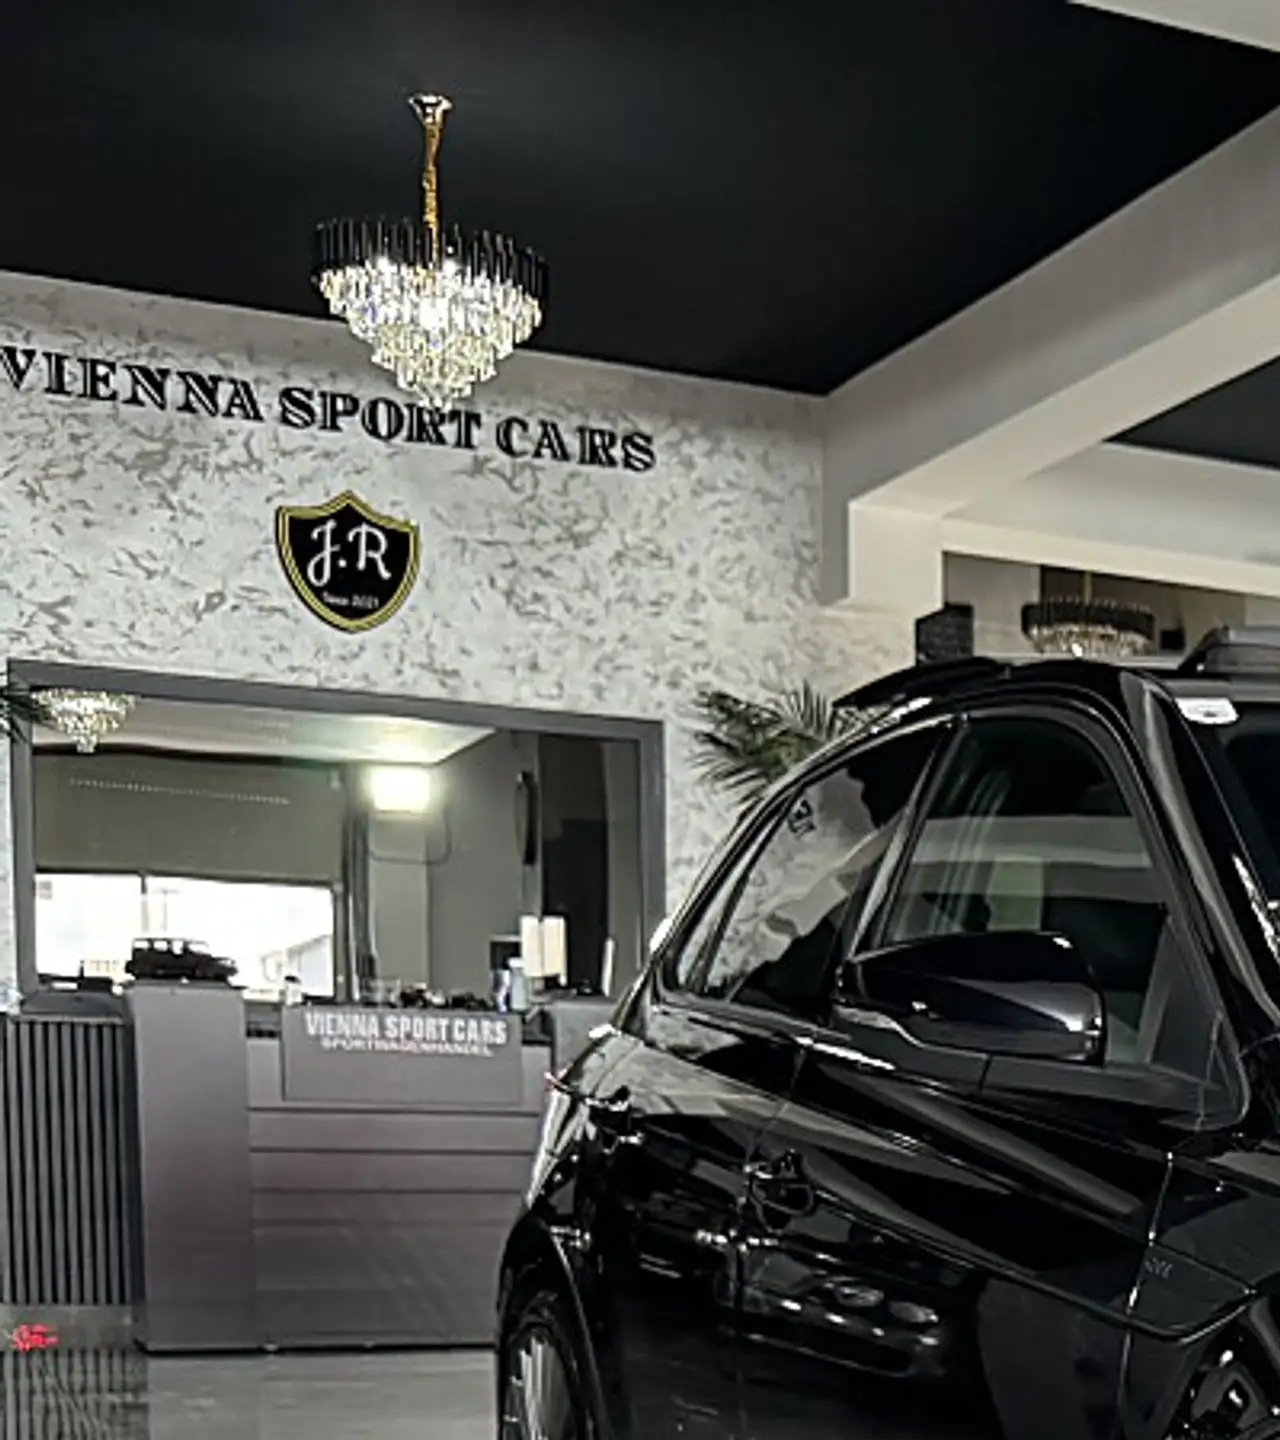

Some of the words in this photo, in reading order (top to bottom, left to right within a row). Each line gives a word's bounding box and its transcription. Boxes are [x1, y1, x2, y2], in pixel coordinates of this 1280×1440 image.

[0, 346, 264, 421] VIENNA
[279, 386, 481, 449] SPORT
[496, 416, 656, 473] CARS
[304, 1012, 380, 1039] VIENNA
[384, 1014, 448, 1042] SPORT
[453, 1017, 508, 1045] CARS
